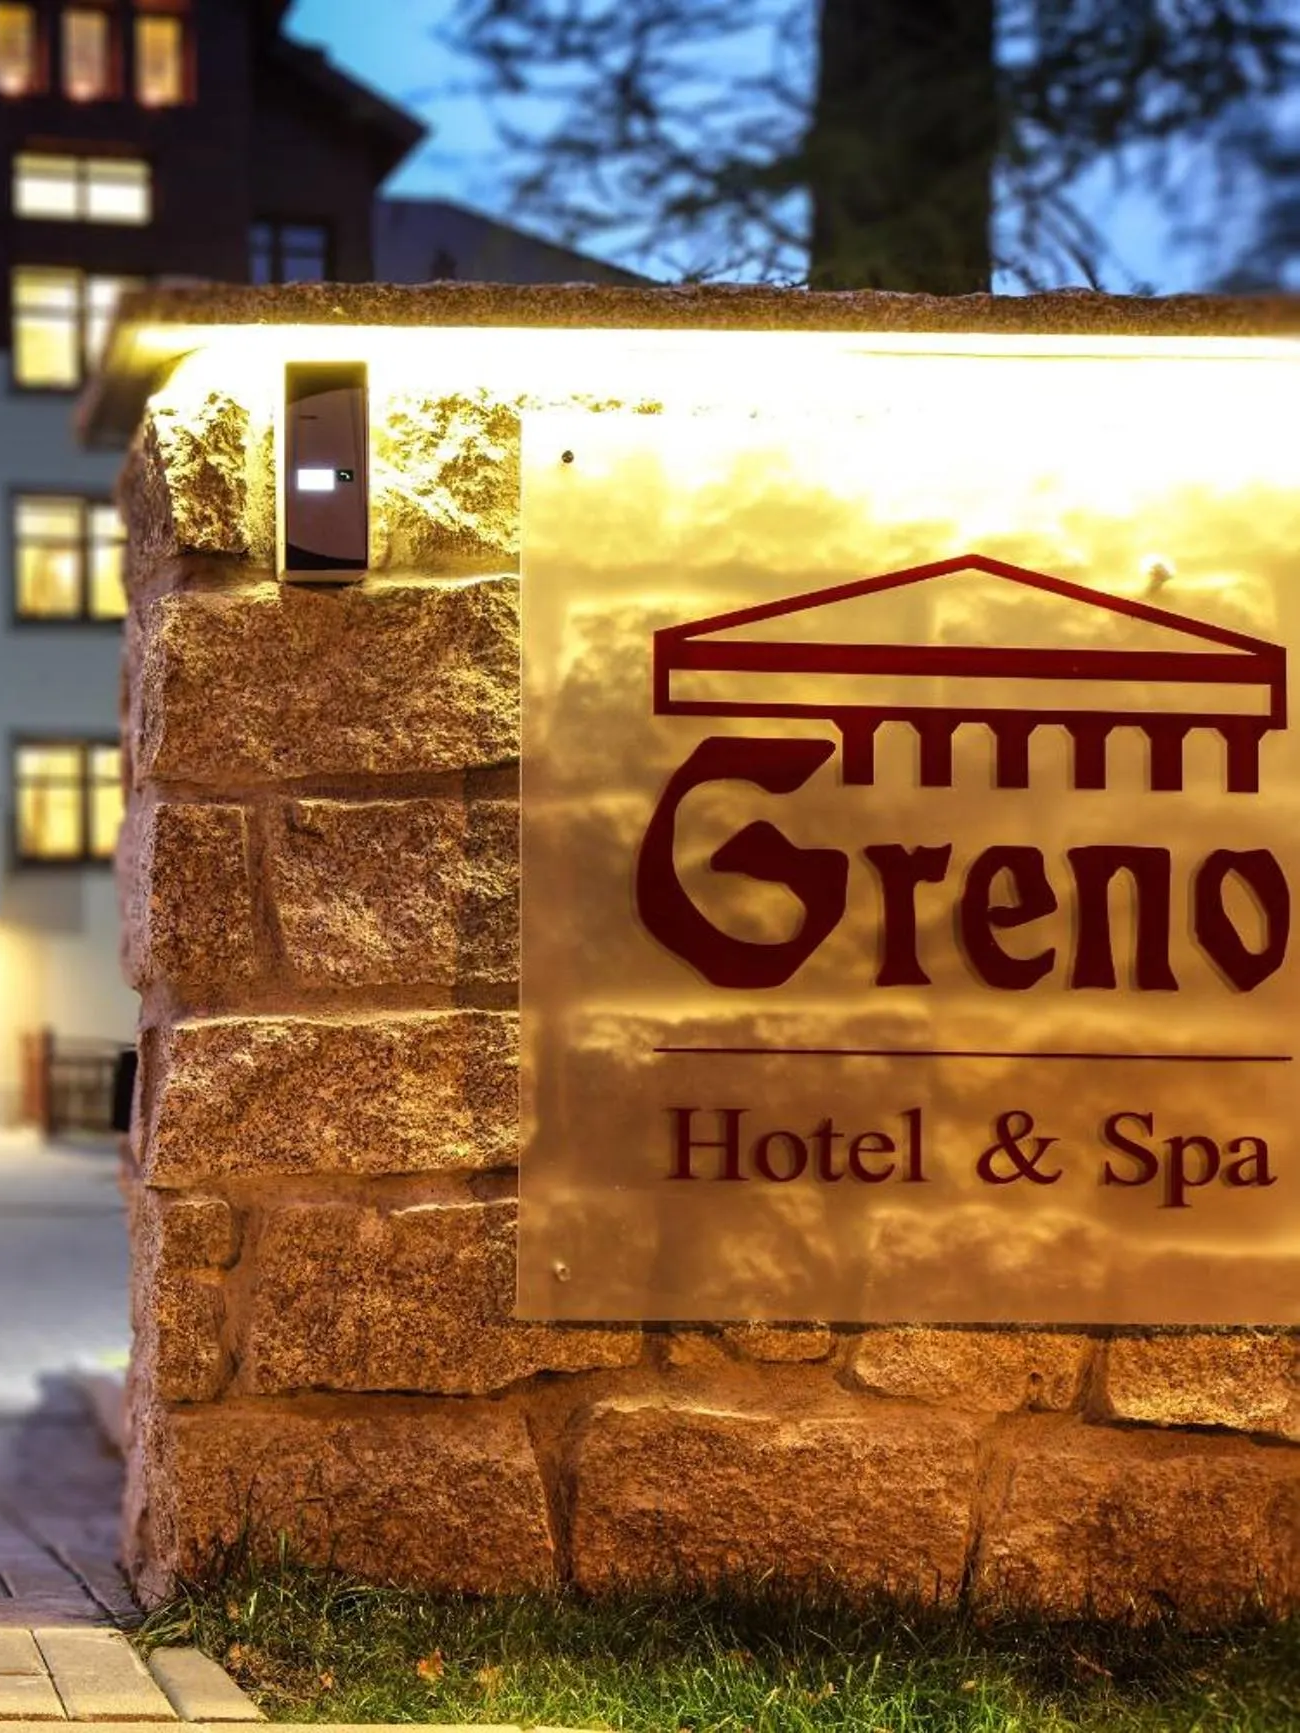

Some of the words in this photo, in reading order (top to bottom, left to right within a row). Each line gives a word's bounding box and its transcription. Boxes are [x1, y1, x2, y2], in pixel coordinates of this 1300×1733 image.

[637, 736, 1291, 992] Greno
[664, 1107, 928, 1183] Hotel
[976, 1110, 1063, 1186] &
[1102, 1112, 1278, 1208] Spa
